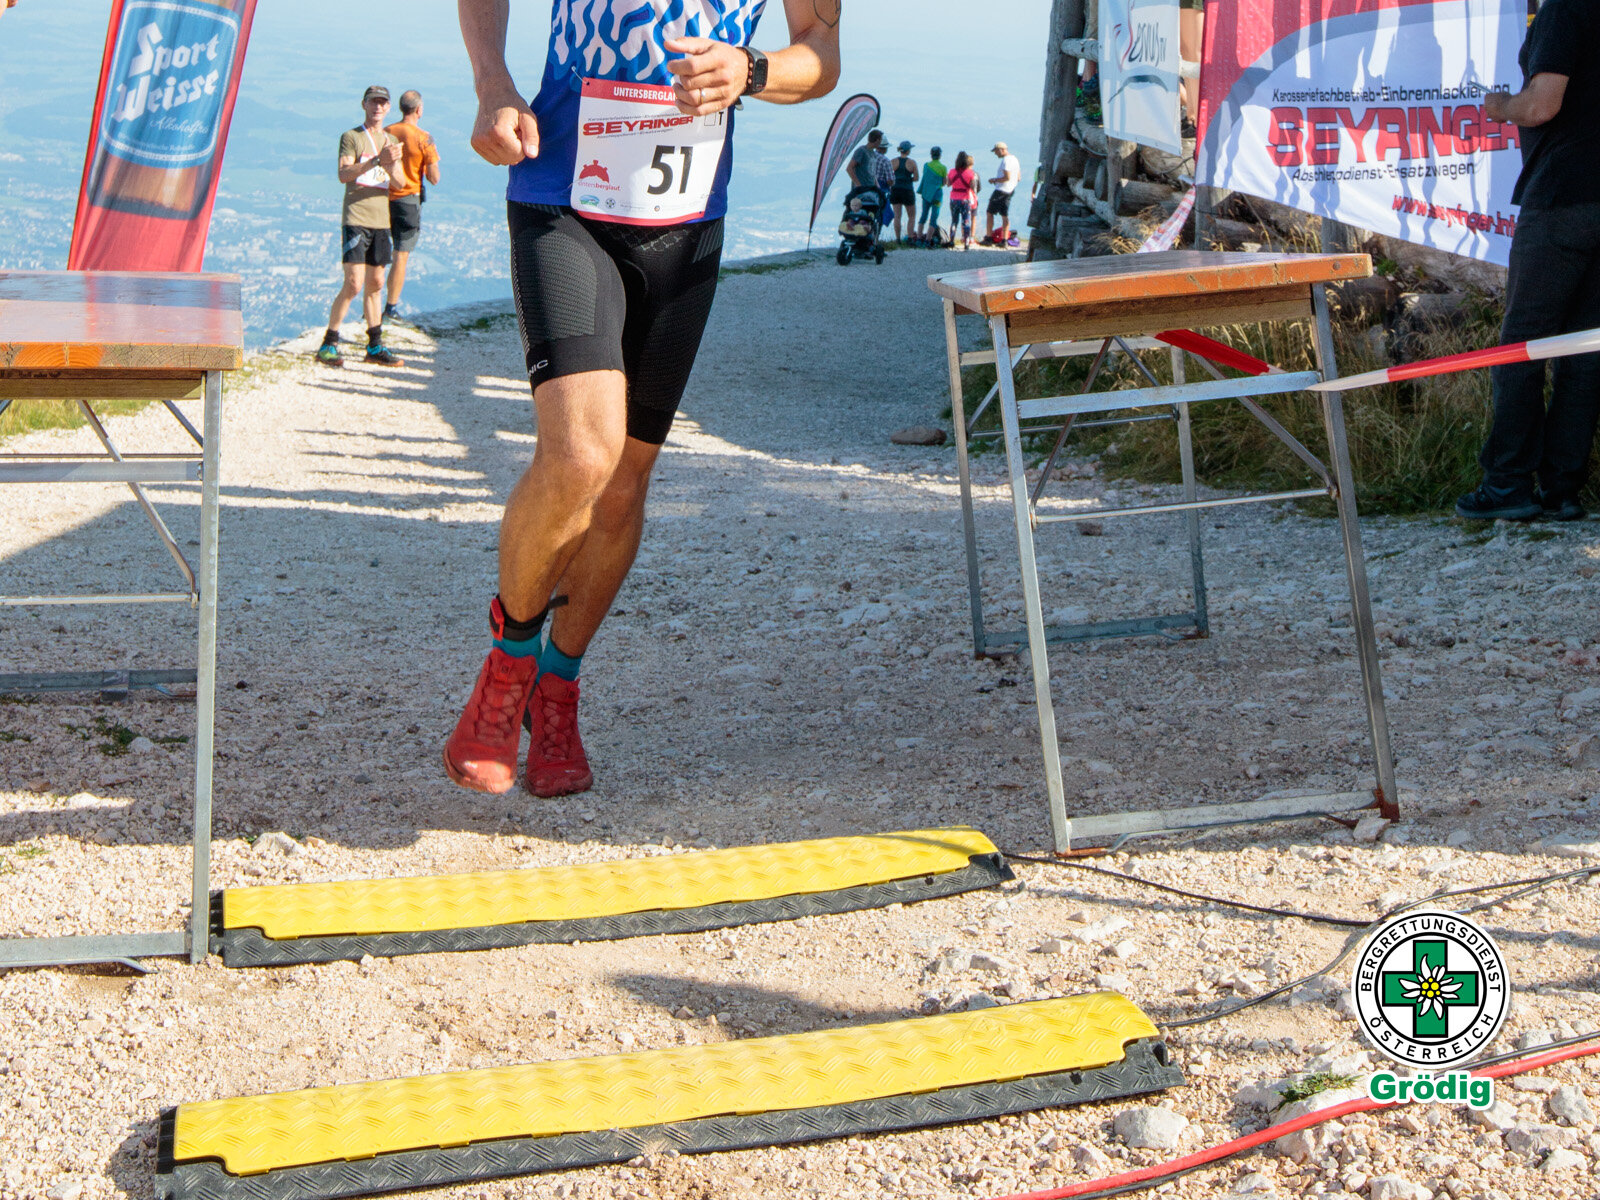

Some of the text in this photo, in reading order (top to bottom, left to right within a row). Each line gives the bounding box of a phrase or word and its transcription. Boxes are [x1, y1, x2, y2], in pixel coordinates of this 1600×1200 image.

[128, 22, 219, 78] Sport
[110, 69, 219, 123] Weisse
[613, 86, 677, 102] UNTERSBERGLA
[582, 115, 694, 136] SEYRINGER
[646, 144, 694, 195] 51
[1392, 195, 1517, 238] www.seyringer-int
[528, 359, 549, 377] NIC
